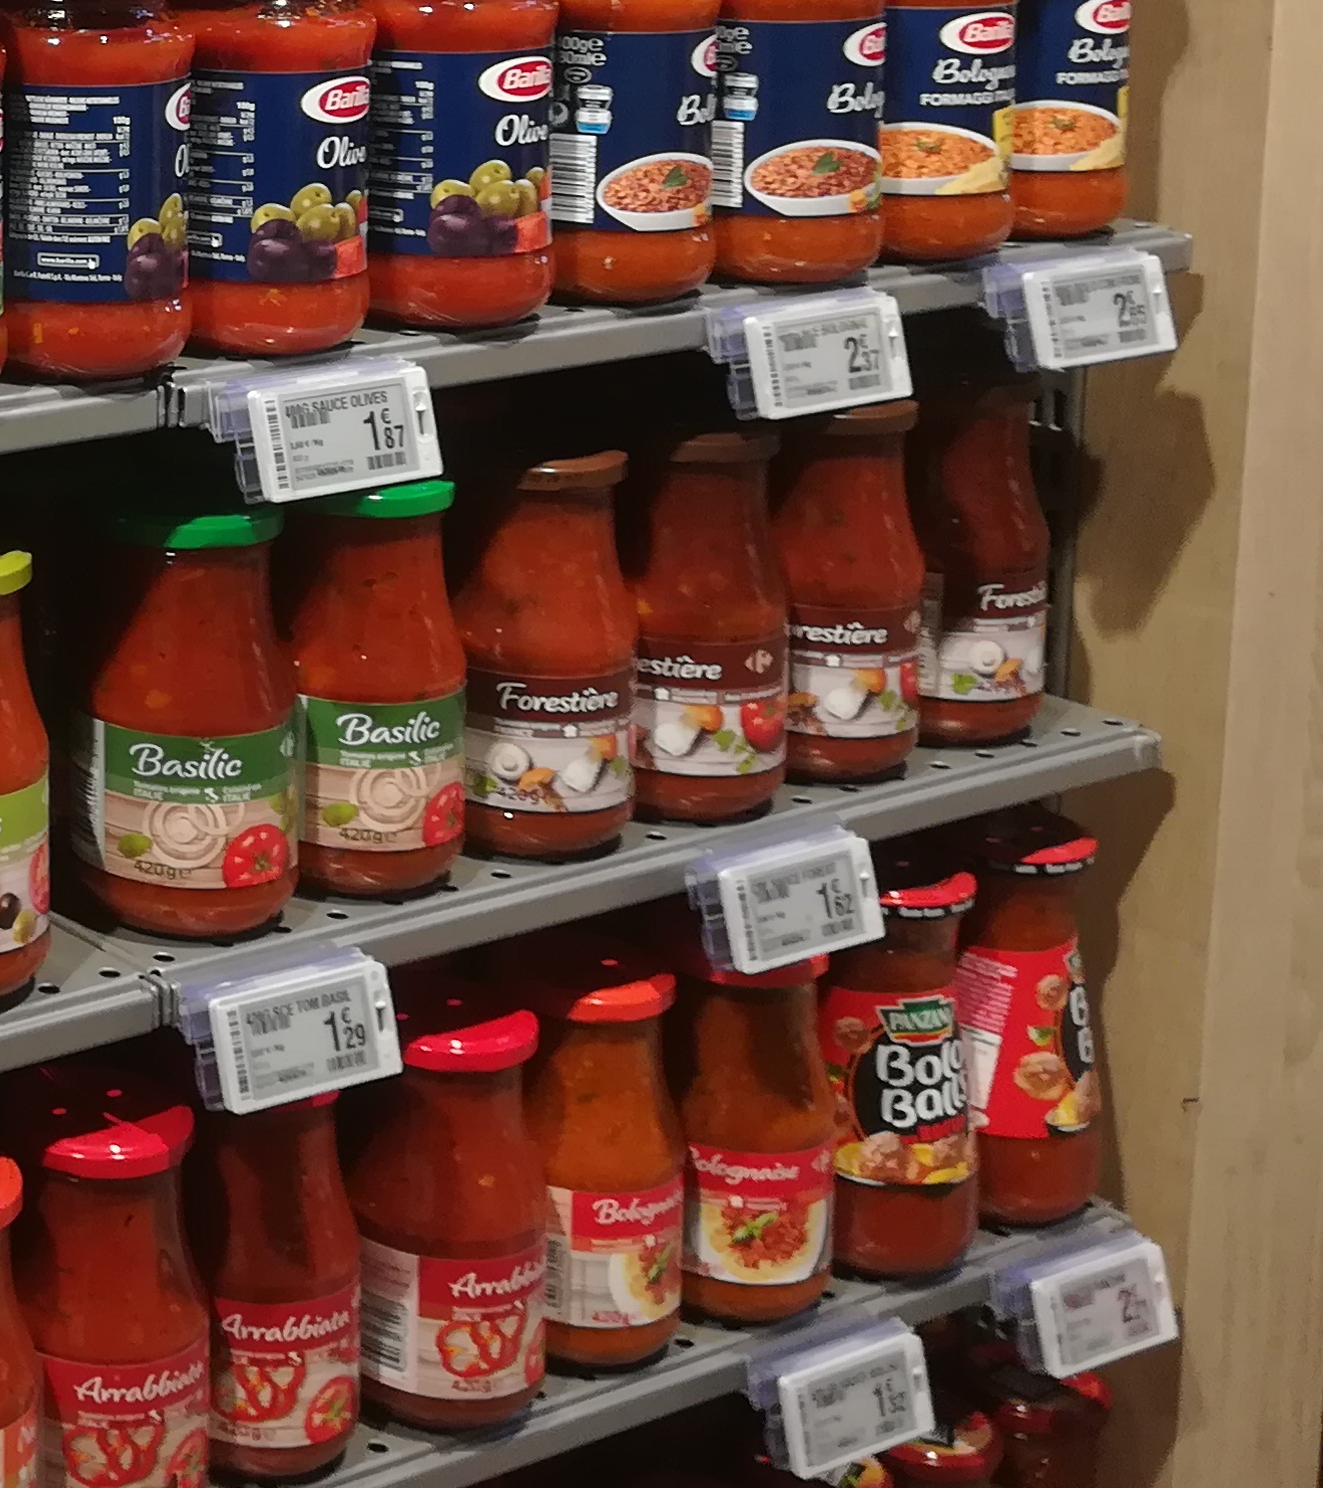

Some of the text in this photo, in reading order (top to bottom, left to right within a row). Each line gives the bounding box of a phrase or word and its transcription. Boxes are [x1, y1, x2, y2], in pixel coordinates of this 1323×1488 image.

[312, 390, 387, 413] SAUCE OLIVES
[497, 682, 619, 711] Forestière
[336, 712, 440, 748] Basilic
[130, 743, 242, 780] Basilic
